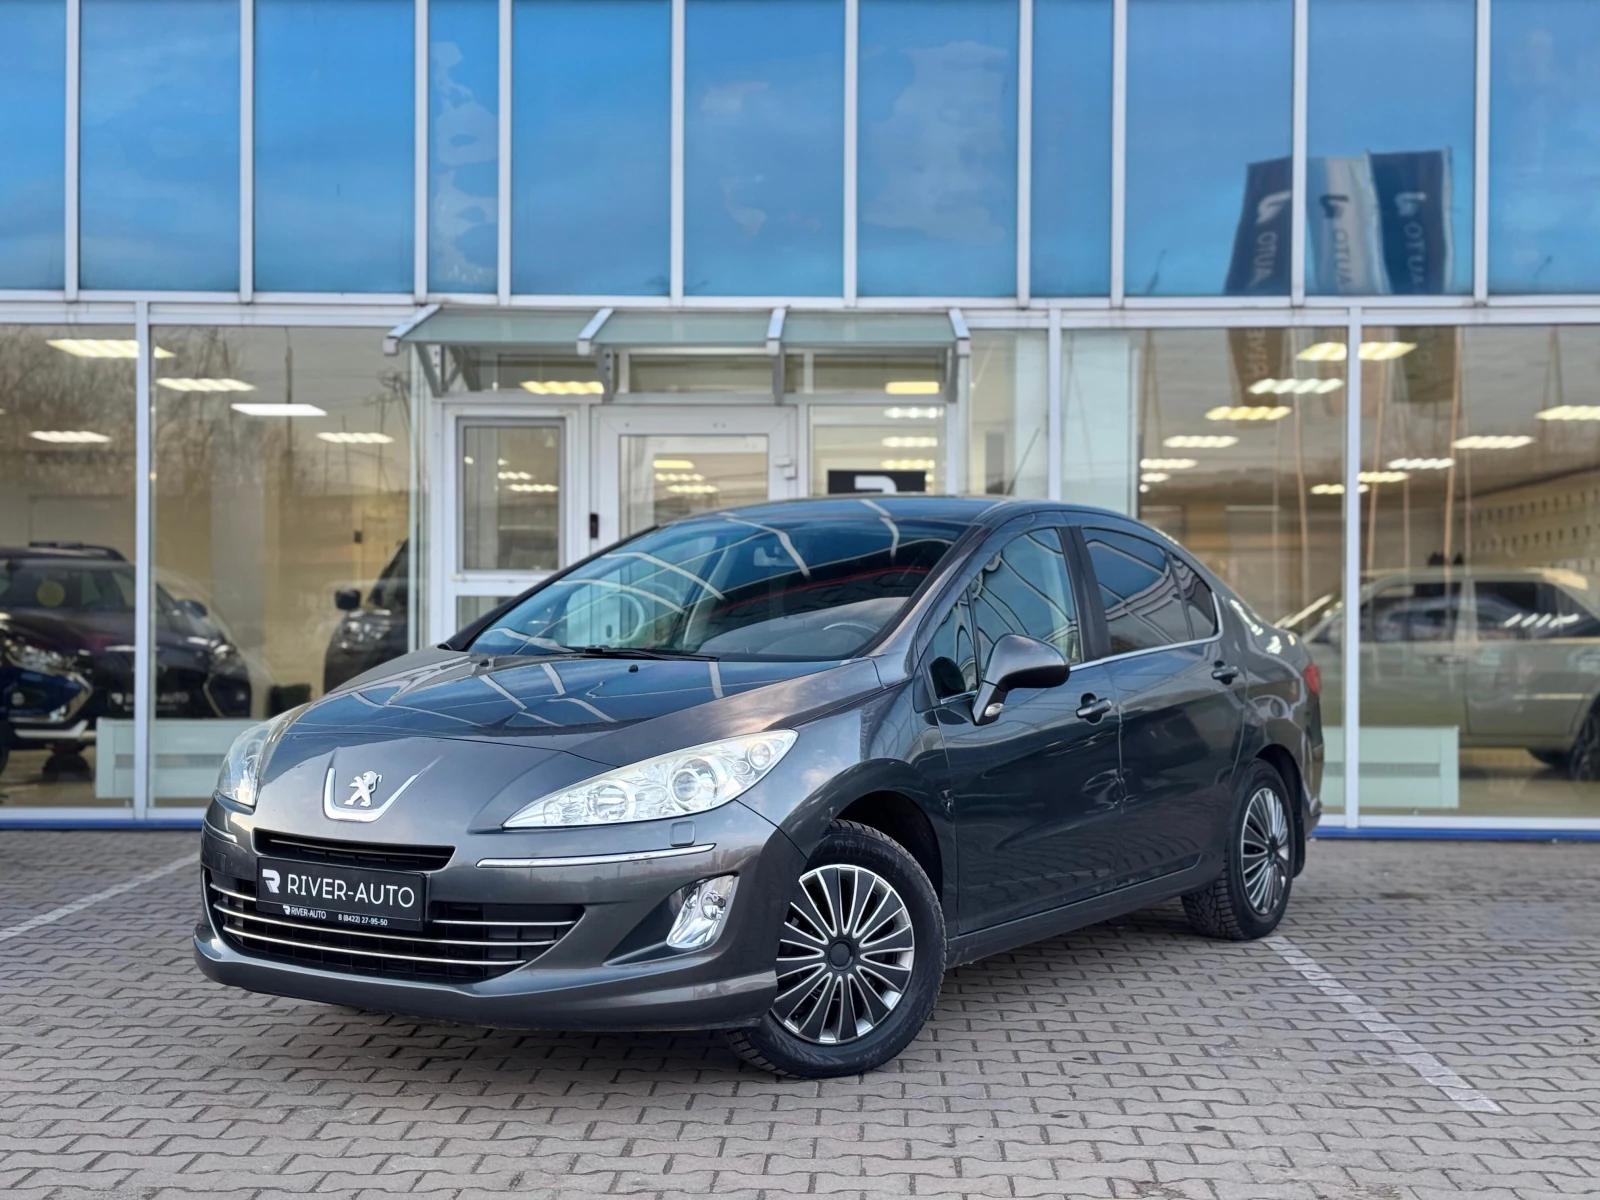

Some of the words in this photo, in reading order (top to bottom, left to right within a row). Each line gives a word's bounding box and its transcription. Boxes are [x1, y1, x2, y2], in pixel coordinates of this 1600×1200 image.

[287, 874, 415, 908] RIVER-AUTO
[290, 906, 327, 919] RIVER-AUTO
[343, 914, 361, 924] (8422)
[361, 917, 388, 926] 27-95-50
